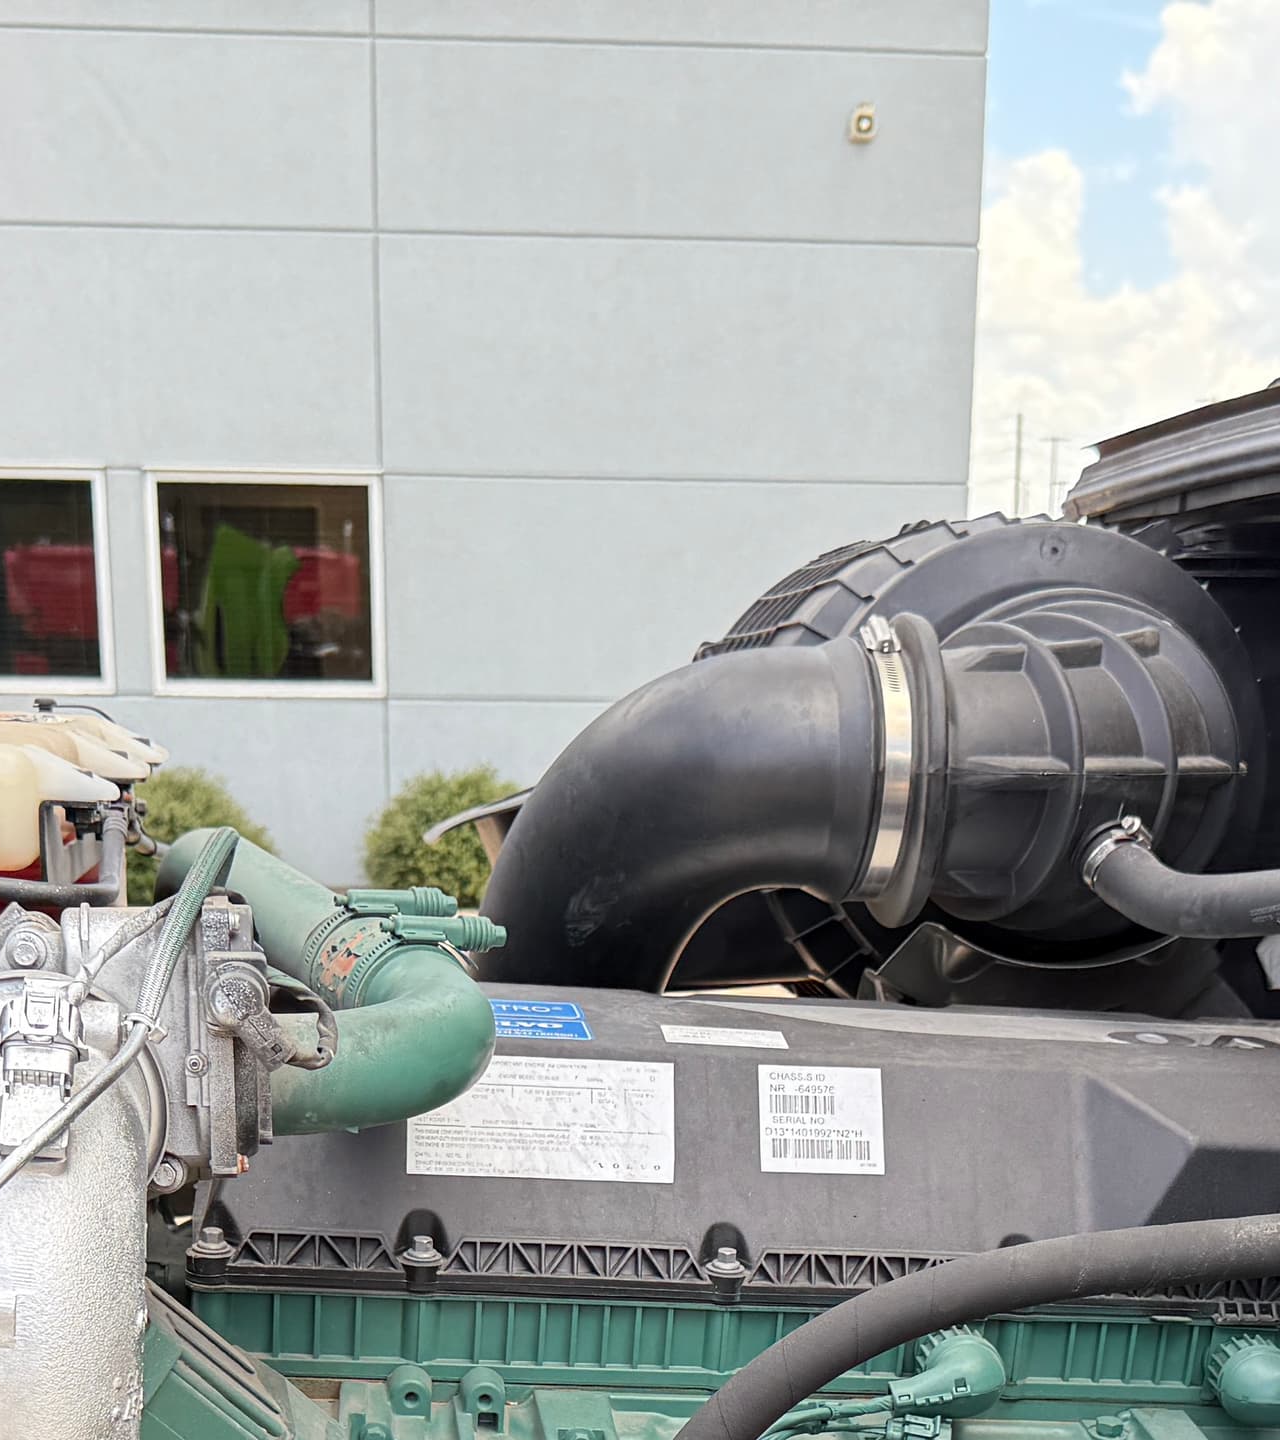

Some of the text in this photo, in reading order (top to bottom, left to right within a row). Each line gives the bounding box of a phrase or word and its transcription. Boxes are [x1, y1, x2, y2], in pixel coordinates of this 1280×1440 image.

[769, 1071, 812, 1082] CHASSS
[769, 1083, 786, 1093] NR
[772, 1116, 825, 1125] SERIAL NO
